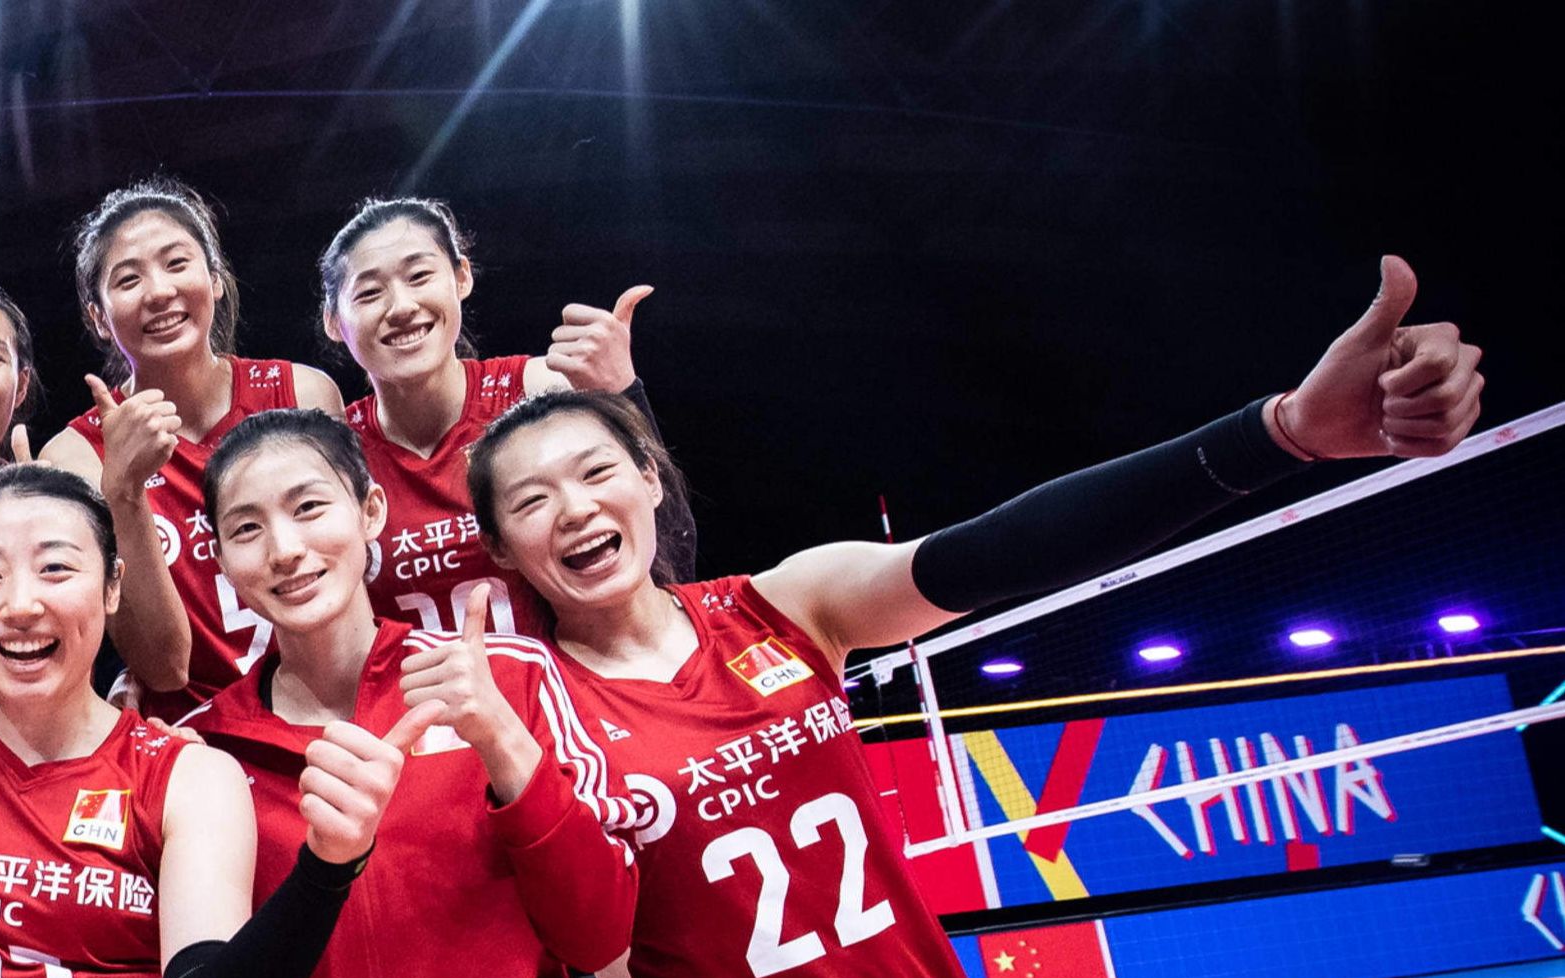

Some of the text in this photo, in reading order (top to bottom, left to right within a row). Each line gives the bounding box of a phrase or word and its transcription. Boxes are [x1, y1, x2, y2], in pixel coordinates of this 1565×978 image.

[395, 550, 461, 580] CPIC
[760, 666, 801, 690] CHN
[697, 774, 780, 822] CPIC
[1130, 724, 1397, 860] CHINA
[73, 823, 119, 843] CHN
